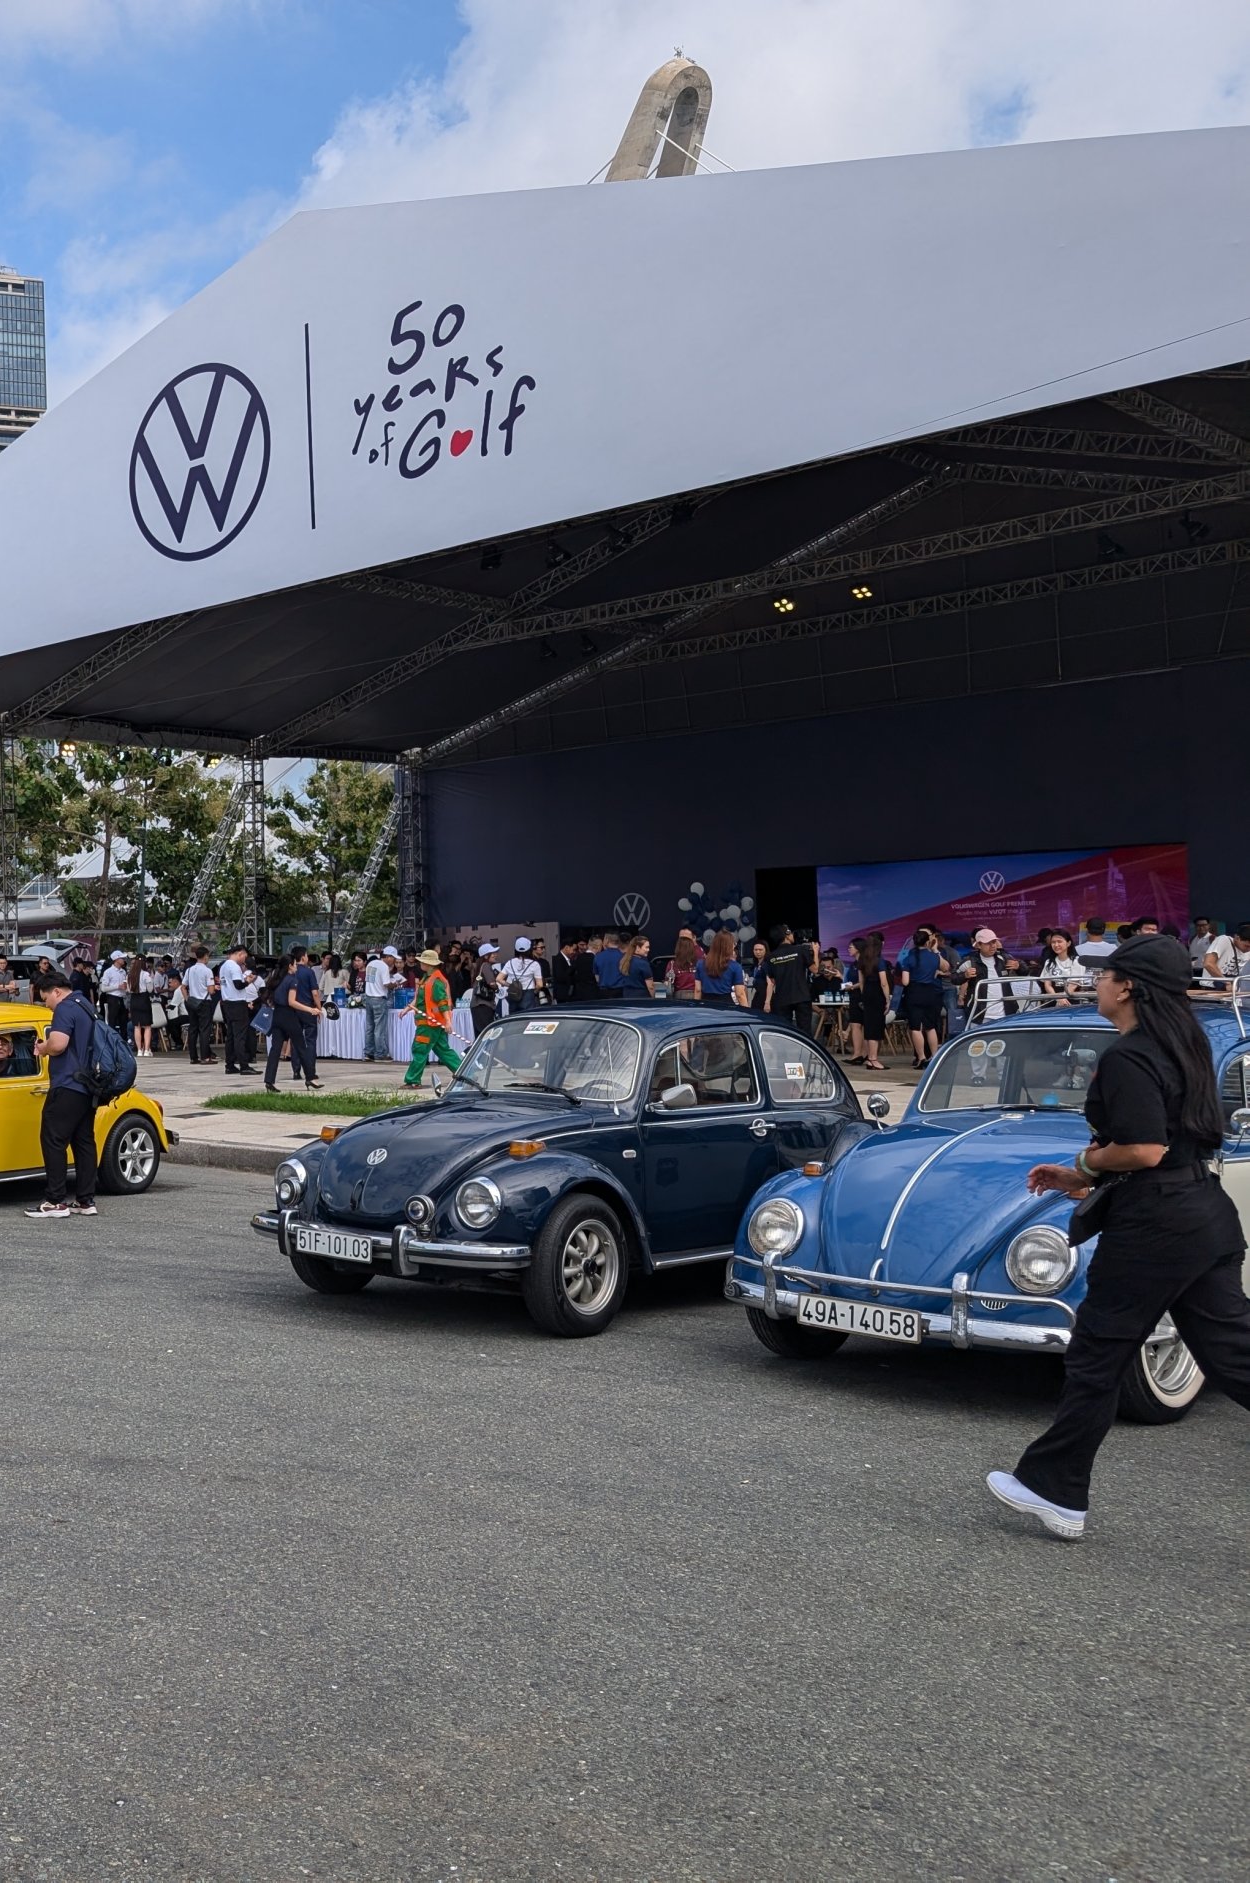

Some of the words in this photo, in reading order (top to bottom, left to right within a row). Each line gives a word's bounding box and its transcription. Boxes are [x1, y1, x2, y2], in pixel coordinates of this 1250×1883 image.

[387, 300, 465, 376] 50
[368, 421, 396, 466] of
[299, 1230, 369, 1259] 51F-101.03
[802, 1298, 916, 1338] 49A-140.58
